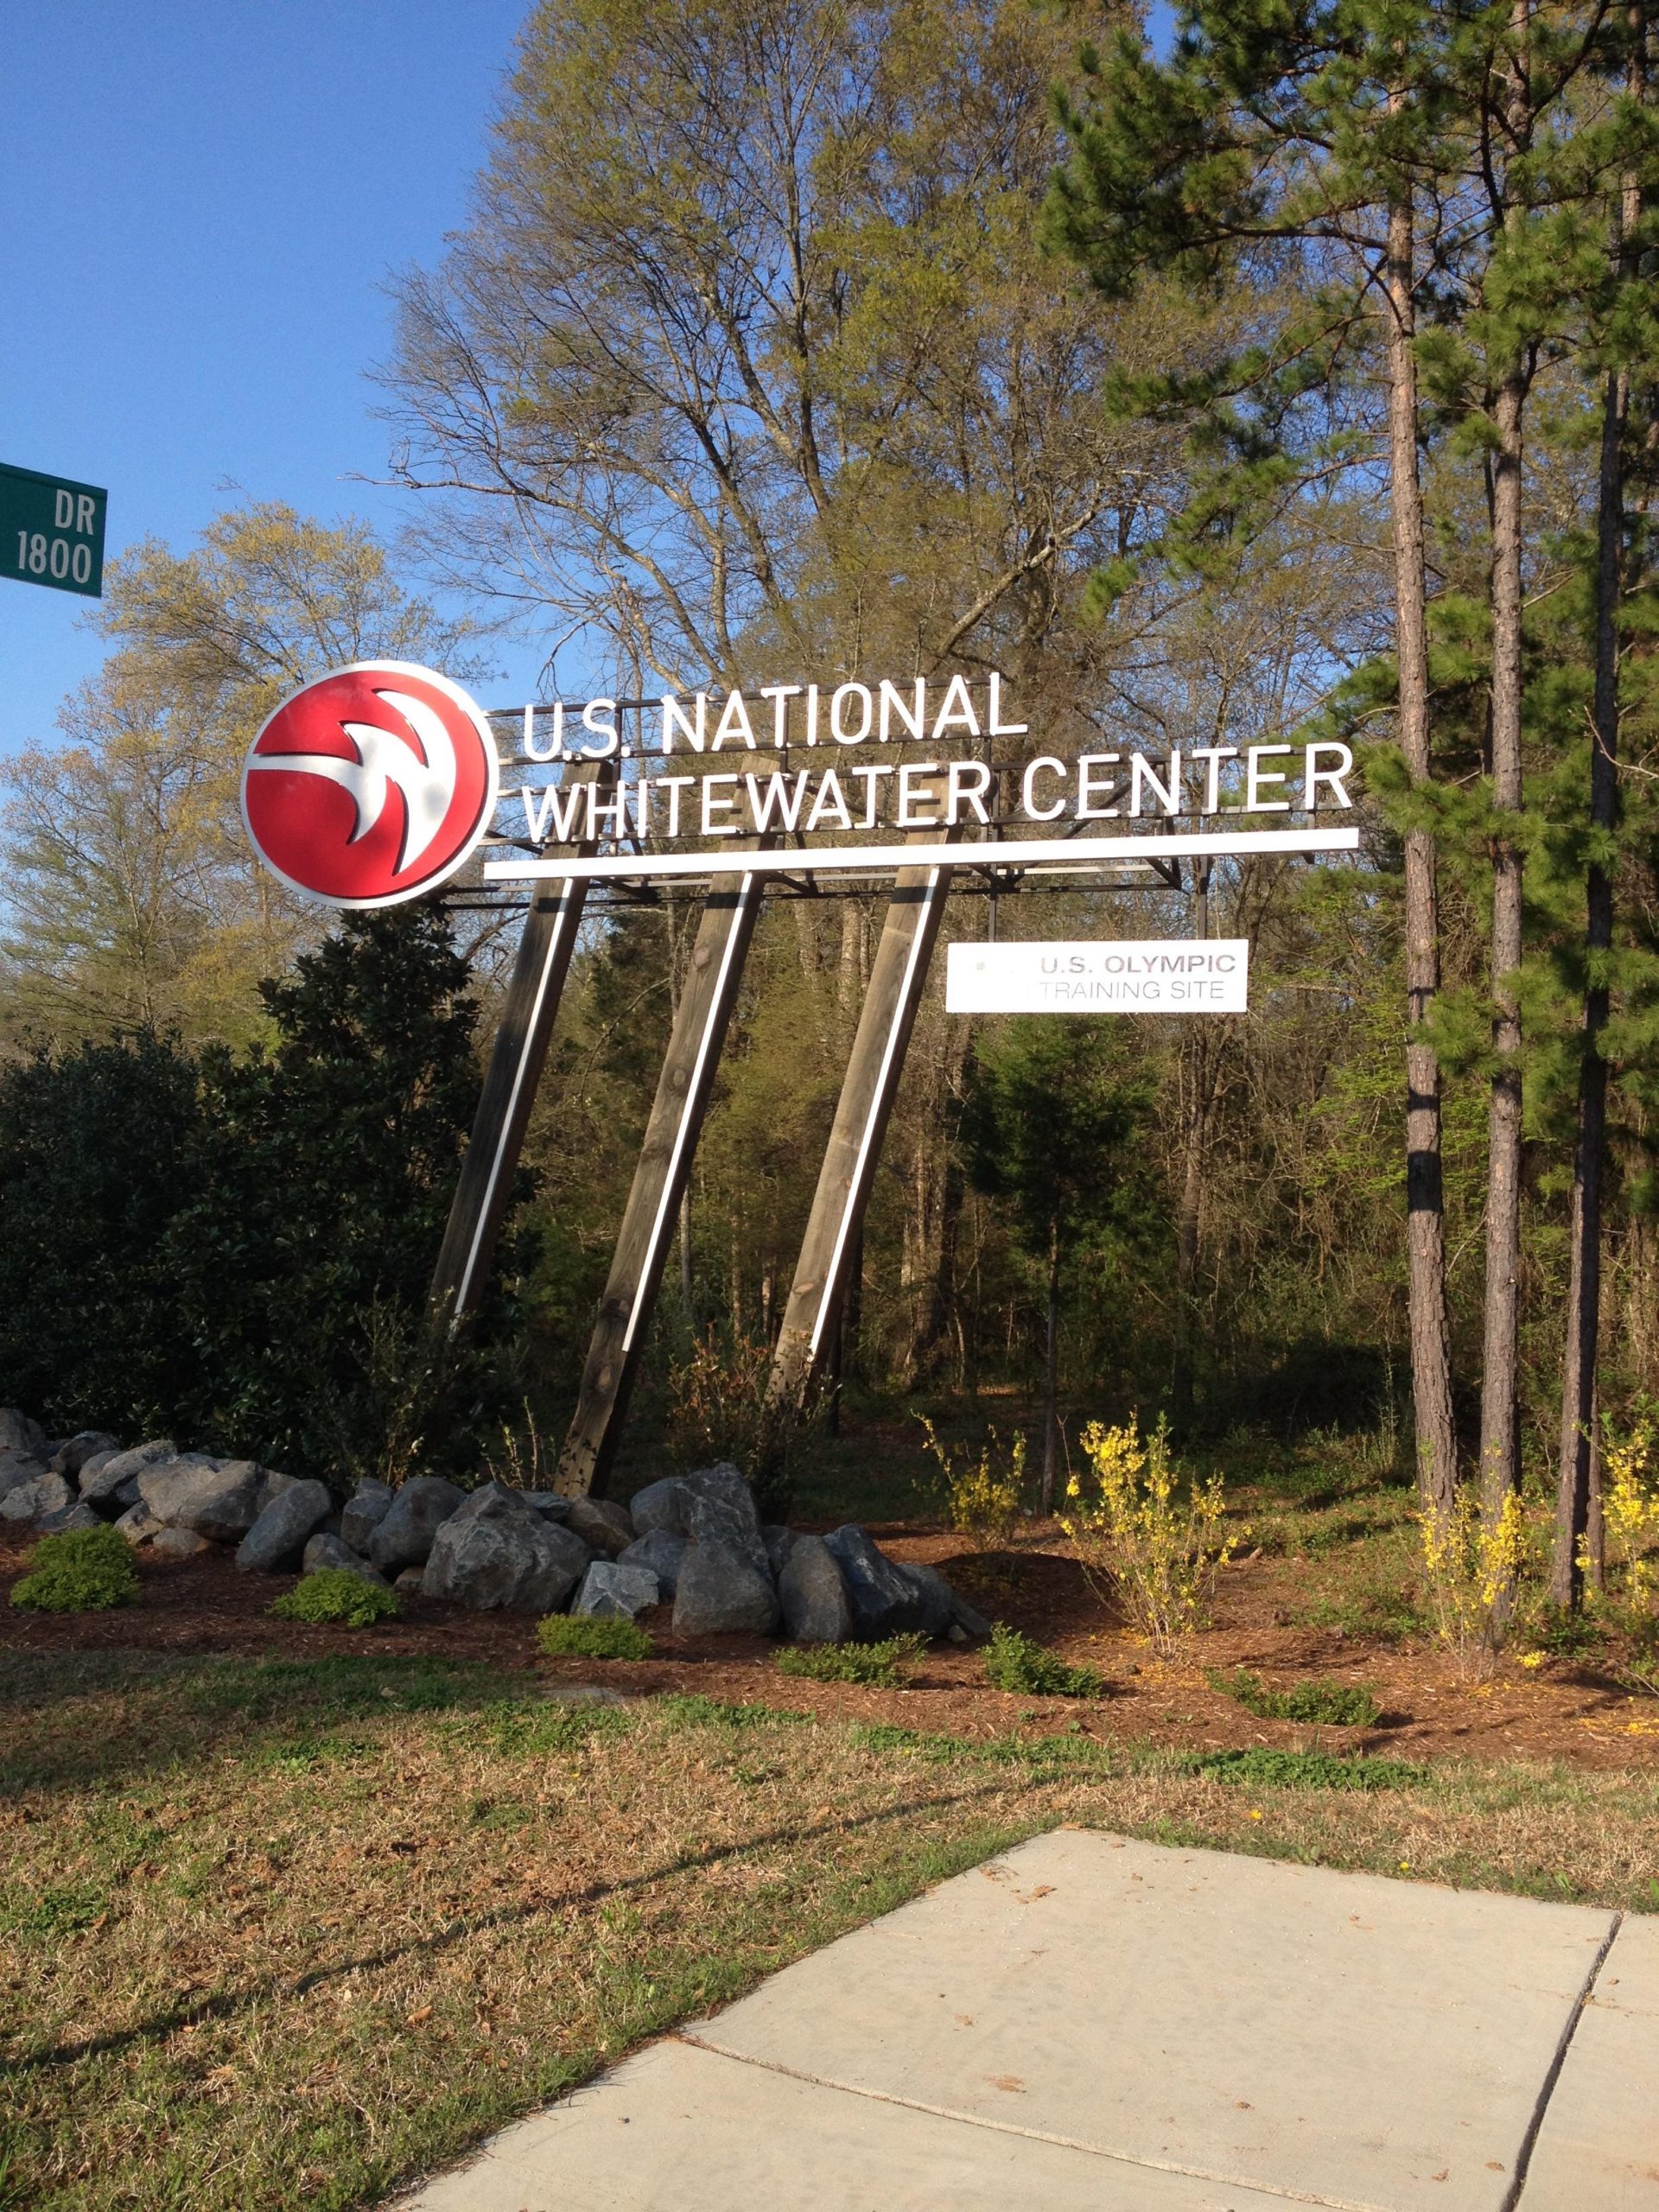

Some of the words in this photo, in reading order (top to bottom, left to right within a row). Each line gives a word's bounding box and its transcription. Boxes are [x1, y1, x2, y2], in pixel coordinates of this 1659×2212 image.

[54, 488, 95, 536] DR
[17, 530, 92, 584] 1800
[660, 671, 1028, 755] NATIONAL
[521, 760, 991, 843] WHITEWATER
[1023, 741, 1353, 822] CENTER
[1040, 956, 1093, 974] U.S.
[1104, 954, 1236, 974] OLYMPIC
[1039, 981, 1160, 1001] TRAINING
[1170, 980, 1225, 1000] SITE
